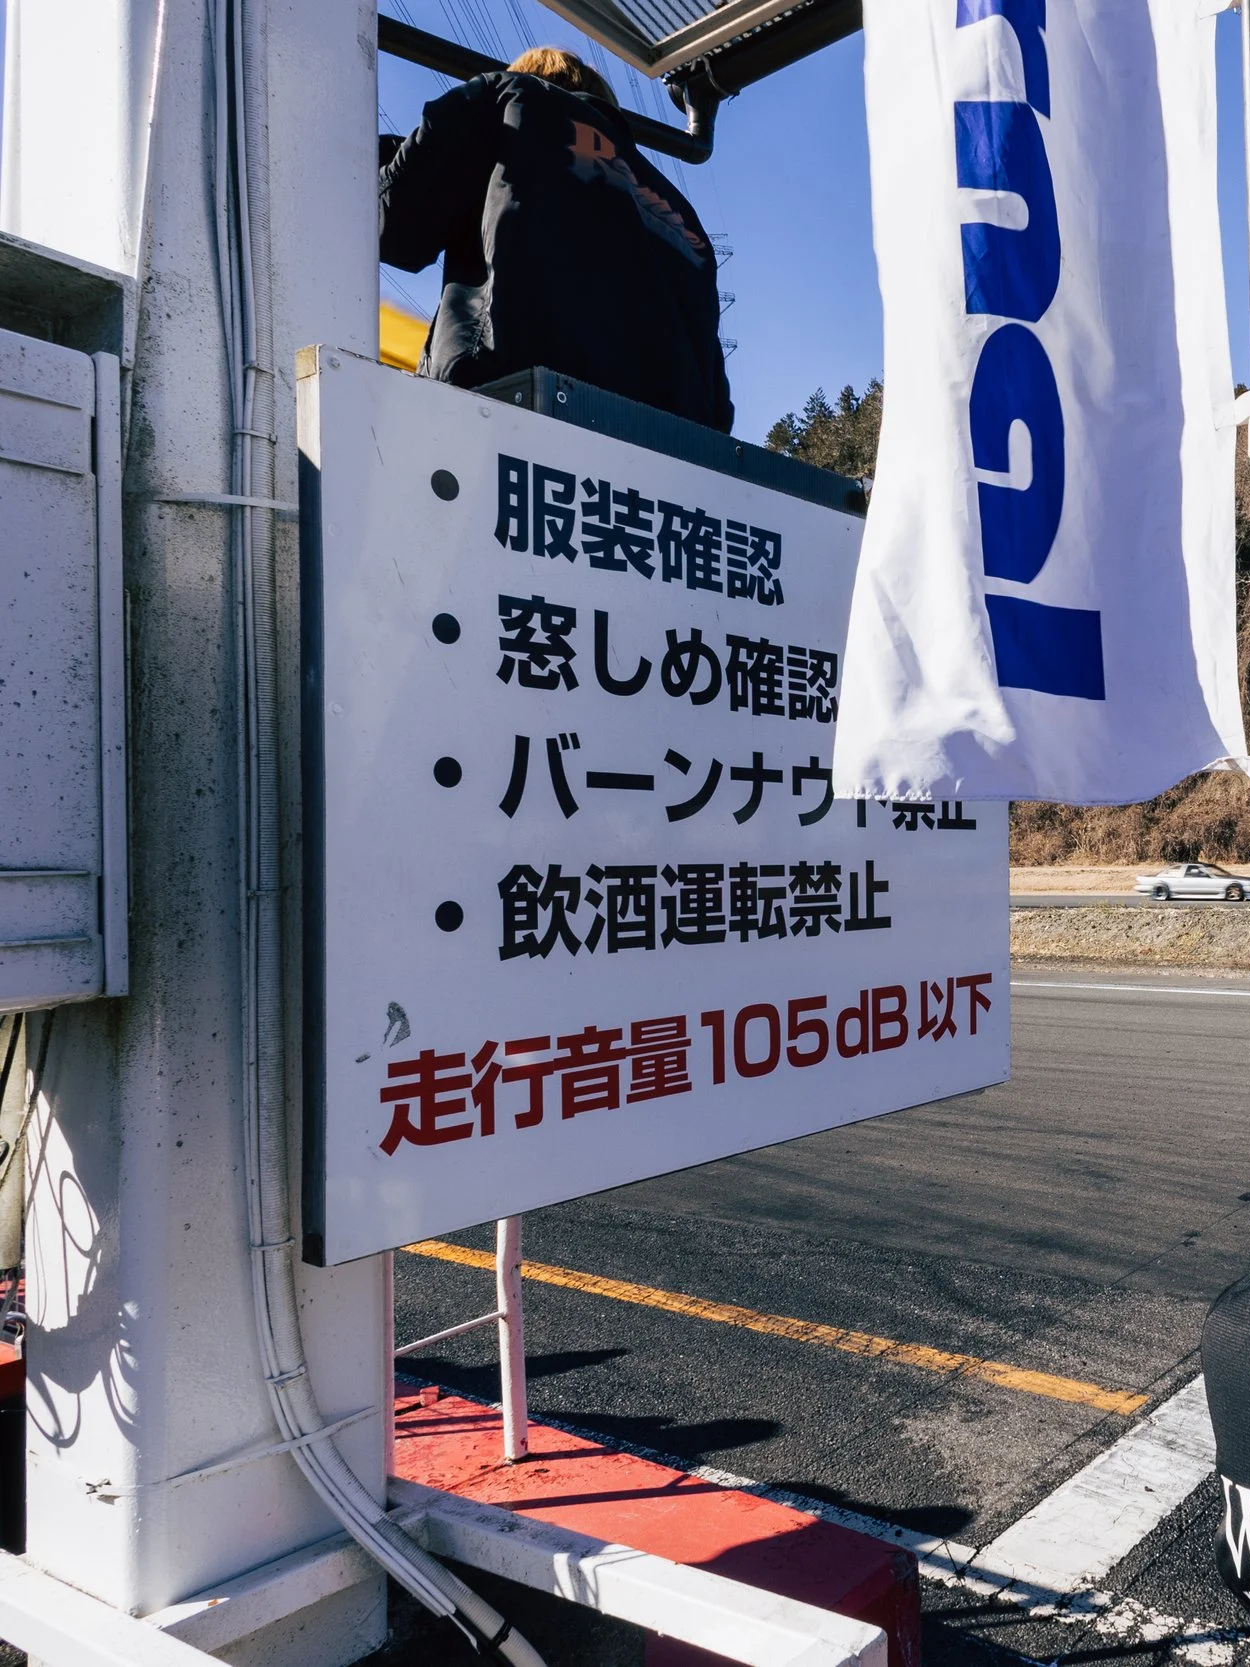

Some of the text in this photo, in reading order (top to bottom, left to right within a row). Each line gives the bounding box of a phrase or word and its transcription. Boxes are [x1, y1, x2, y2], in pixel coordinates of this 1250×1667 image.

[495, 453, 784, 606] 服装確認
[496, 594, 839, 723] 窓しめ確認
[497, 860, 891, 961] 飲酒運転禁止
